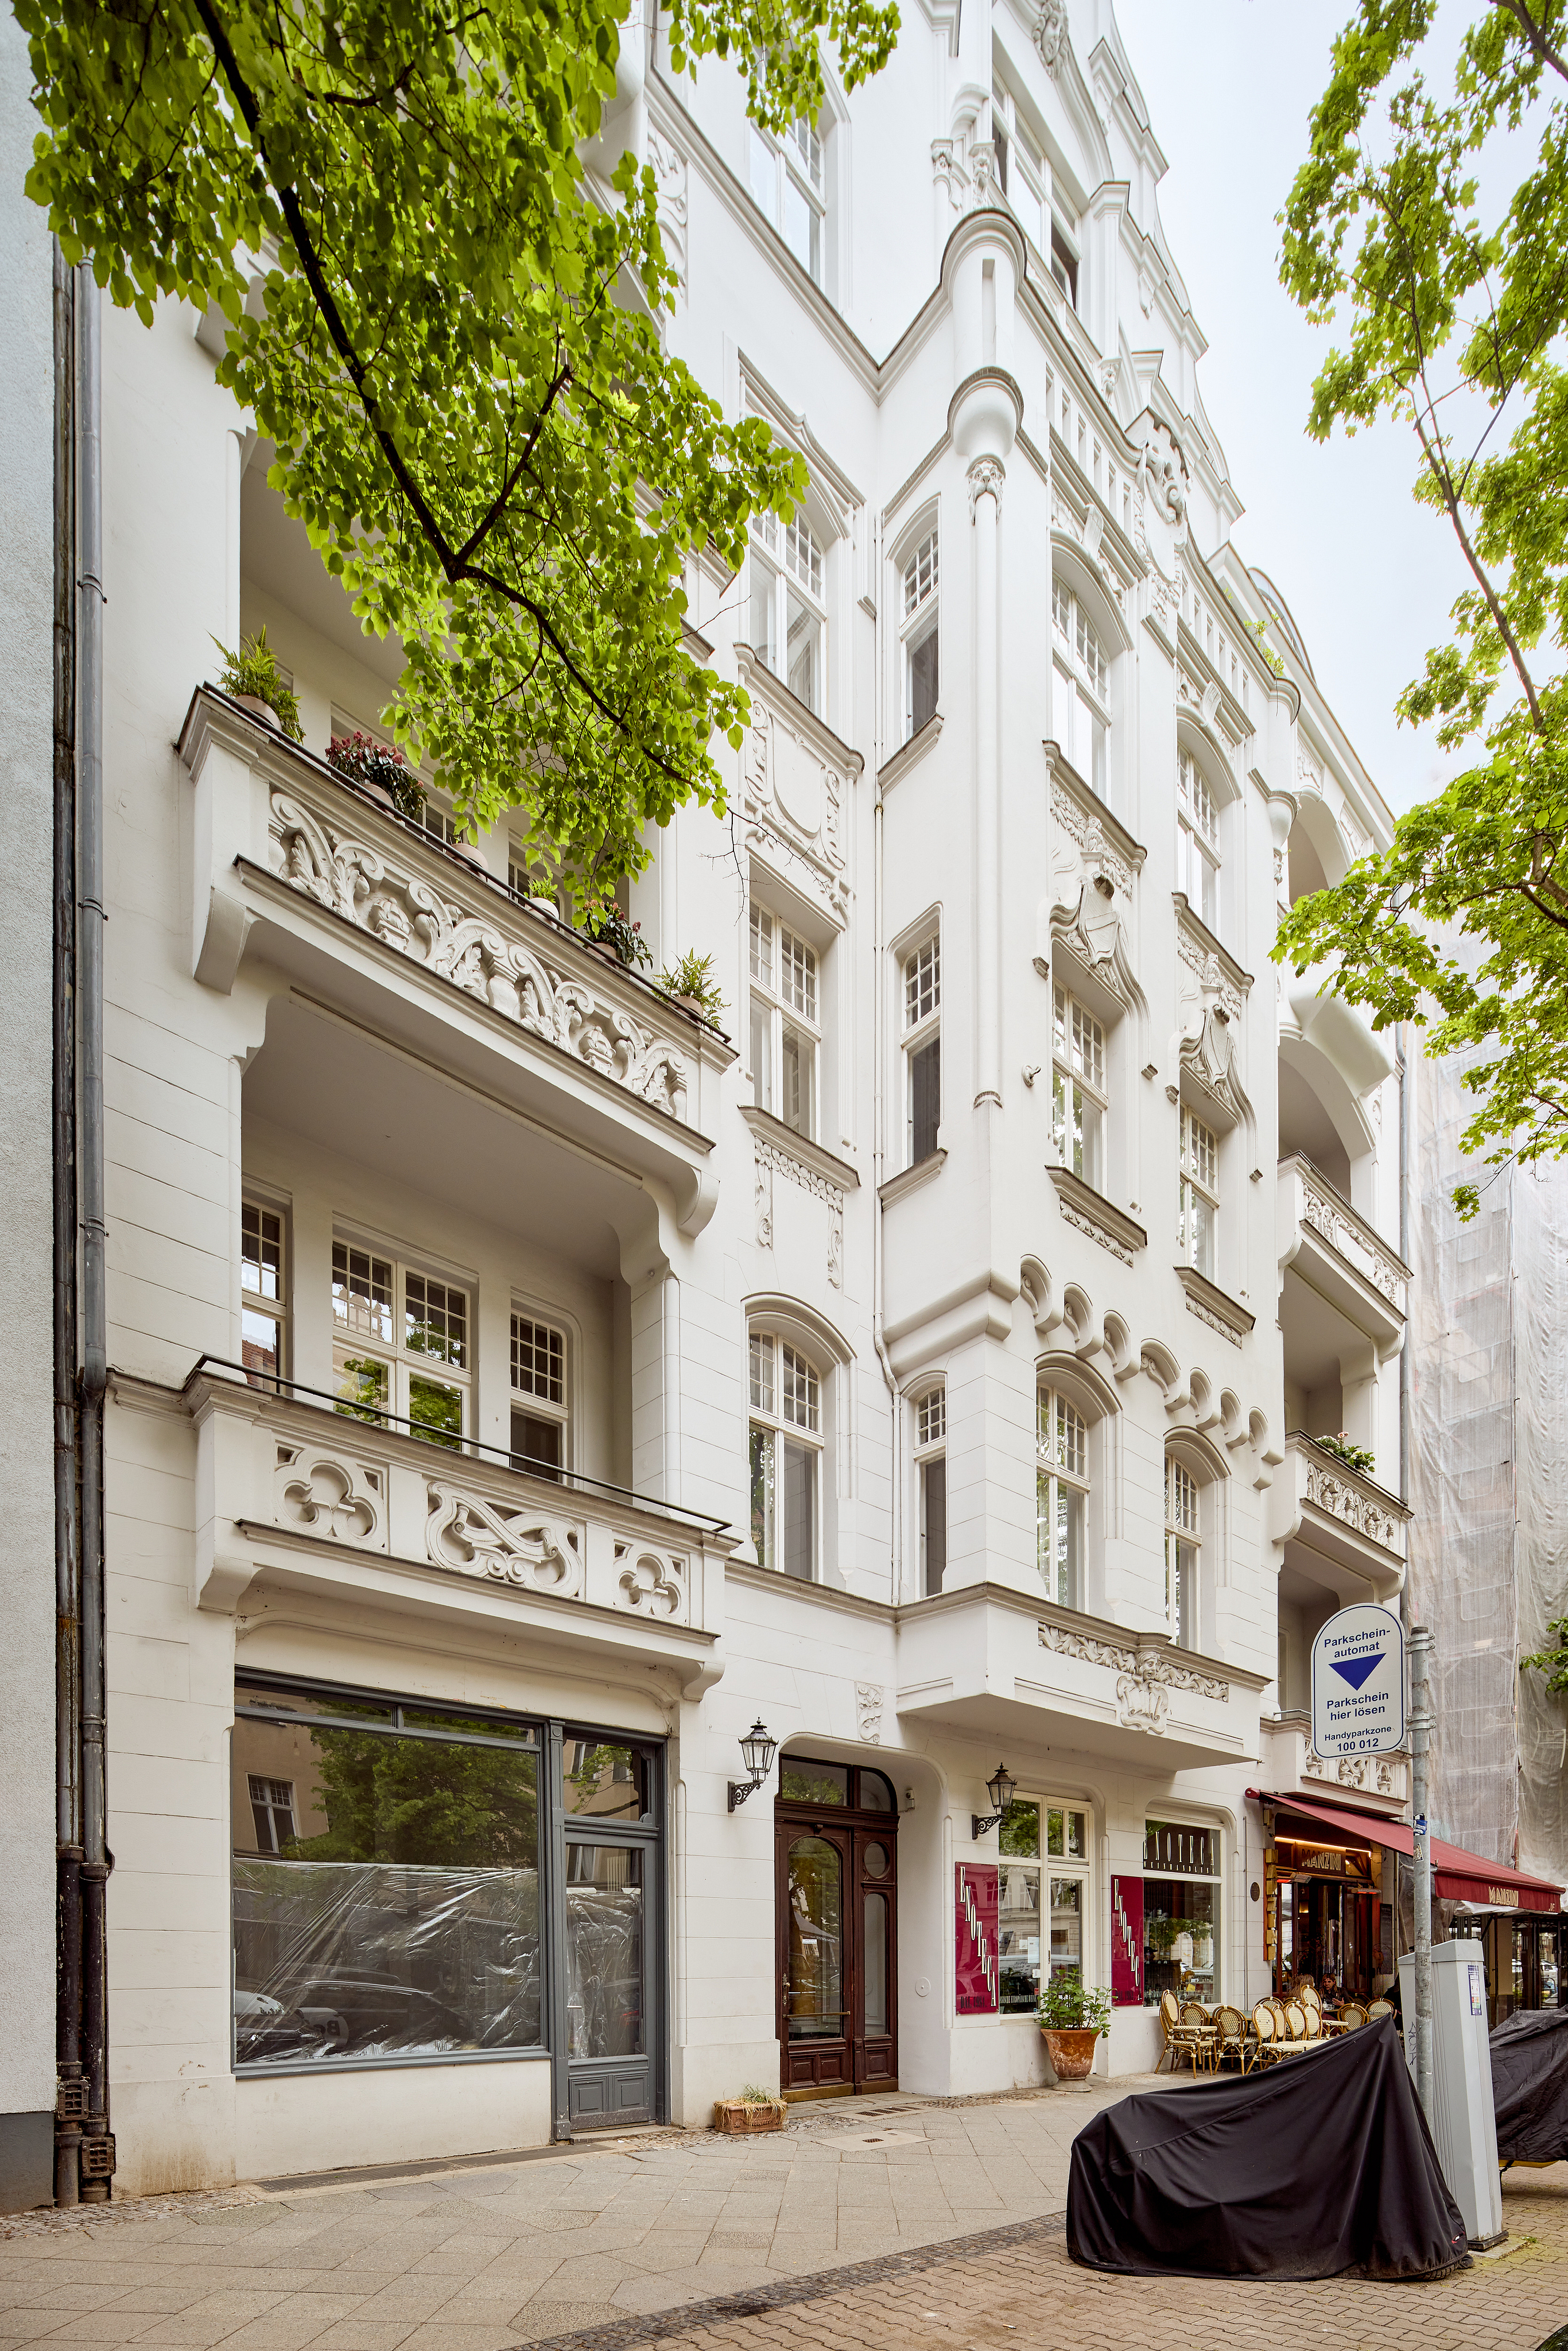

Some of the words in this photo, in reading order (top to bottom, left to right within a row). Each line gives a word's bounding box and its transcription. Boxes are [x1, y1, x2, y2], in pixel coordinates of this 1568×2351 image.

[1324, 1628, 1391, 1648] Parkschein-
[1334, 1641, 1380, 1658] automat
[1327, 1692, 1389, 1709] Parkschein
[1330, 1711, 1352, 1721] hier
[1354, 1706, 1385, 1717] lösen
[1325, 1726, 1392, 1741] Handyparkzone
[1337, 1741, 1356, 1752] 100
[1359, 1738, 1379, 1749] 012
[1143, 1830, 1214, 1866] ENOTECA
[1301, 1848, 1342, 1871] MANZINI
[1488, 1886, 1519, 1907] MANZINI
[960, 1866, 997, 2007] ENOTECA
